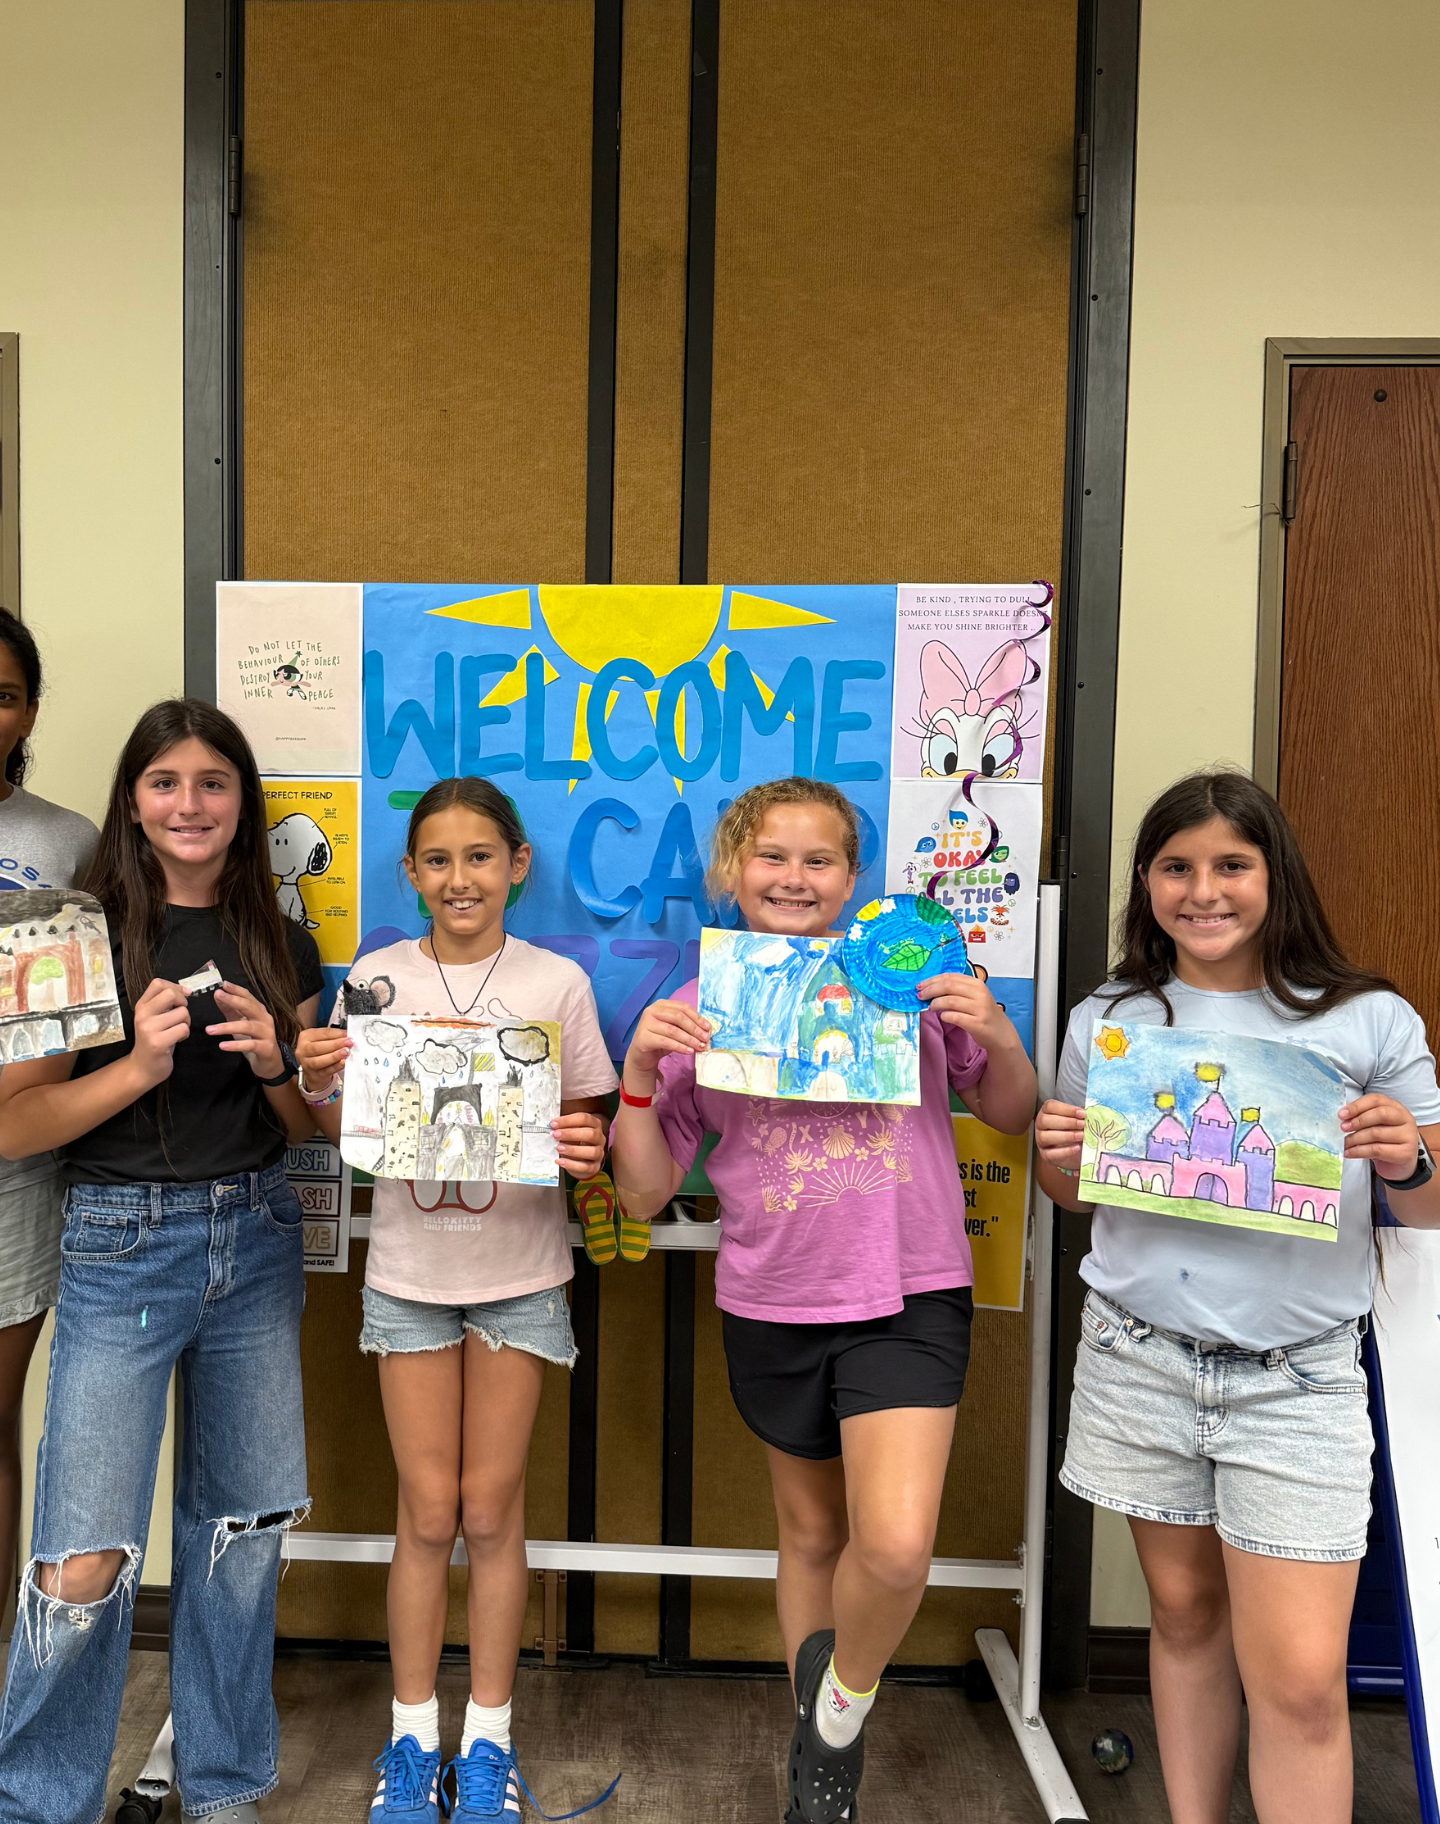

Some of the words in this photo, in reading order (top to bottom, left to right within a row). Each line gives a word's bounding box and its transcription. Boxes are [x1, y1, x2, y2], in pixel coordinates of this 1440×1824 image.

[959, 596, 991, 604] TRYING
[248, 645, 259, 655] DO
[263, 640, 280, 651] NOT
[286, 640, 302, 650] LET
[306, 642, 322, 653] THE
[238, 654, 283, 669] BEHAVIOUR
[301, 657, 310, 667] OF
[315, 656, 340, 666] OTHERS
[240, 672, 270, 686] DESTROY
[305, 671, 323, 681] YOUR
[244, 688, 273, 700] INNER
[308, 689, 334, 702] PEACE
[363, 650, 886, 782] WELCOME
[301, 791, 333, 799] FRIEND
[941, 831, 982, 849] IT'S
[954, 868, 1002, 886] FEEL
[960, 887, 1003, 904] THE
[949, 907, 988, 923] ELS
[971, 1159, 983, 1181] is
[986, 1160, 1011, 1184] the
[964, 1216, 999, 1237] ver."
